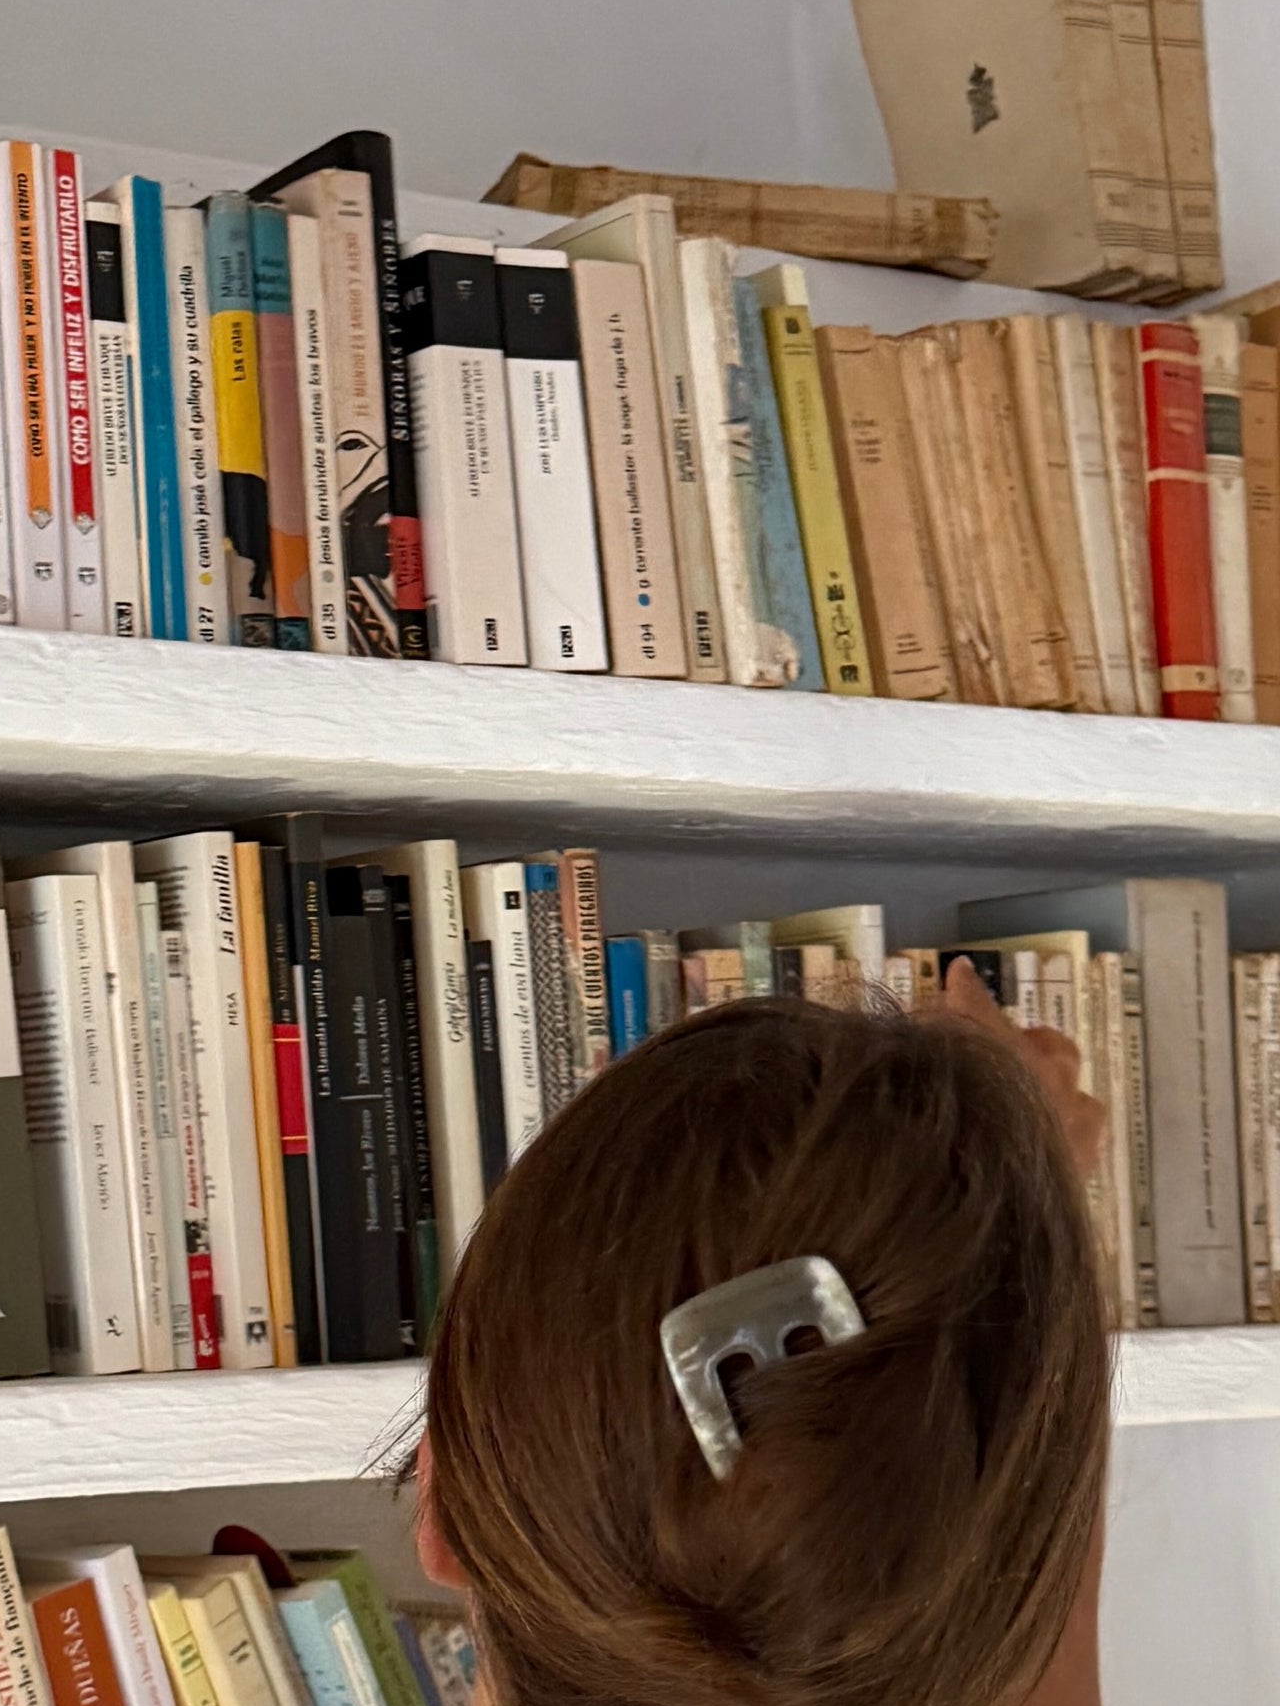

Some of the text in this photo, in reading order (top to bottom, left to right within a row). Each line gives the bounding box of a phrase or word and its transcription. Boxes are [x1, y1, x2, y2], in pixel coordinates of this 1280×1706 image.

[58, 175, 90, 465] COMO SER INFELIZ Y DISFRUTARLO
[179, 265, 197, 328] cuadrilla
[186, 332, 199, 351] su
[230, 322, 245, 381] Las ratas
[377, 219, 410, 440] SEÑORAS Y SEÑORES
[187, 370, 208, 423] gallego
[191, 428, 205, 441] el
[193, 484, 212, 515] josé
[195, 518, 212, 567] camilo
[198, 606, 214, 625] 27
[212, 855, 236, 955] La familia
[575, 865, 598, 941] PEREGRINOS
[510, 931, 525, 967] luna
[580, 946, 602, 999] CUENTOS
[515, 1004, 530, 1023] de
[13, 1635, 32, 1659] de
[59, 1606, 99, 1702] DUEÑAS
